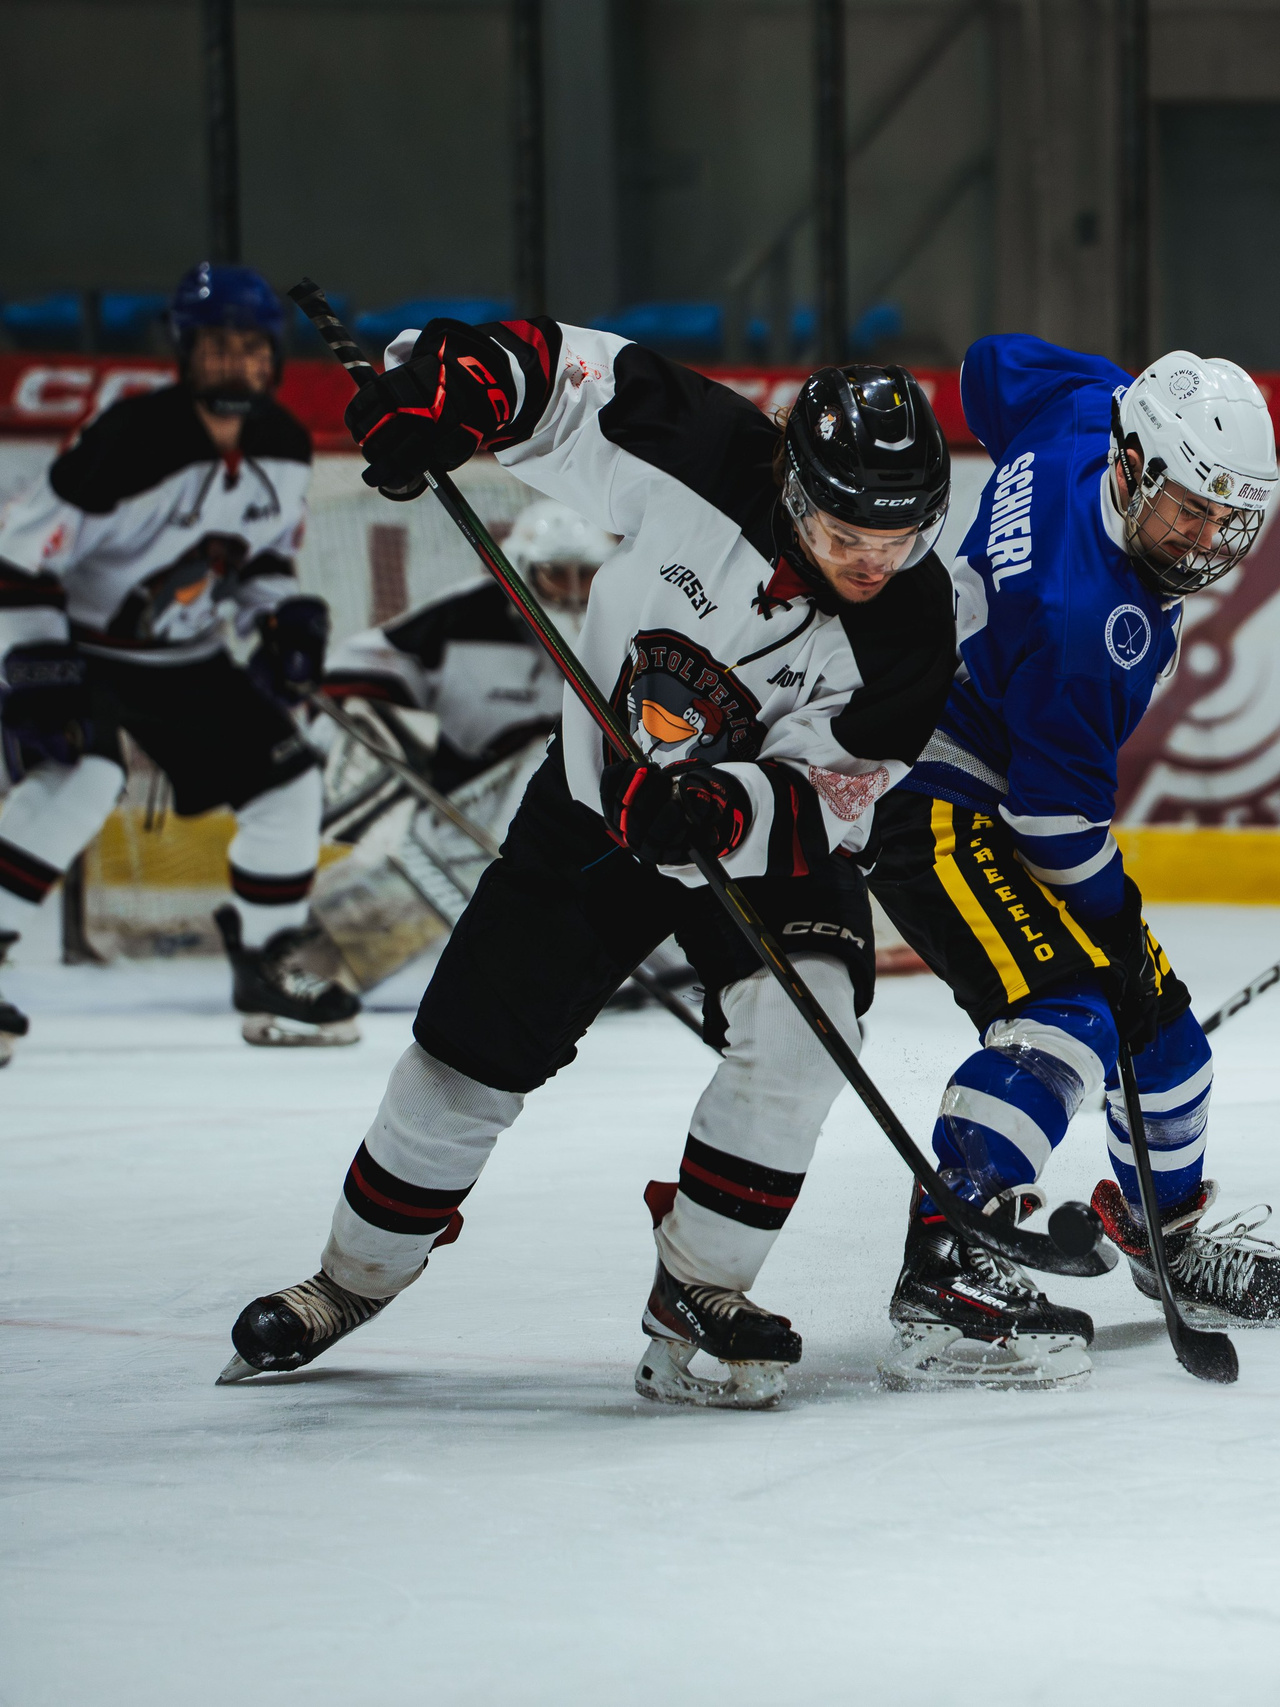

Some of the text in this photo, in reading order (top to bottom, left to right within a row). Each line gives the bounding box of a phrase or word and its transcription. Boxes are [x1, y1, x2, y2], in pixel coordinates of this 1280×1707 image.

[456, 355, 510, 431] CC
[1174, 369, 1200, 399] TWISTED FIST
[873, 496, 917, 507] CCM
[987, 451, 1035, 593] SCHIERL
[782, 920, 866, 950] CCM
[951, 1281, 1008, 1310] BAUER
